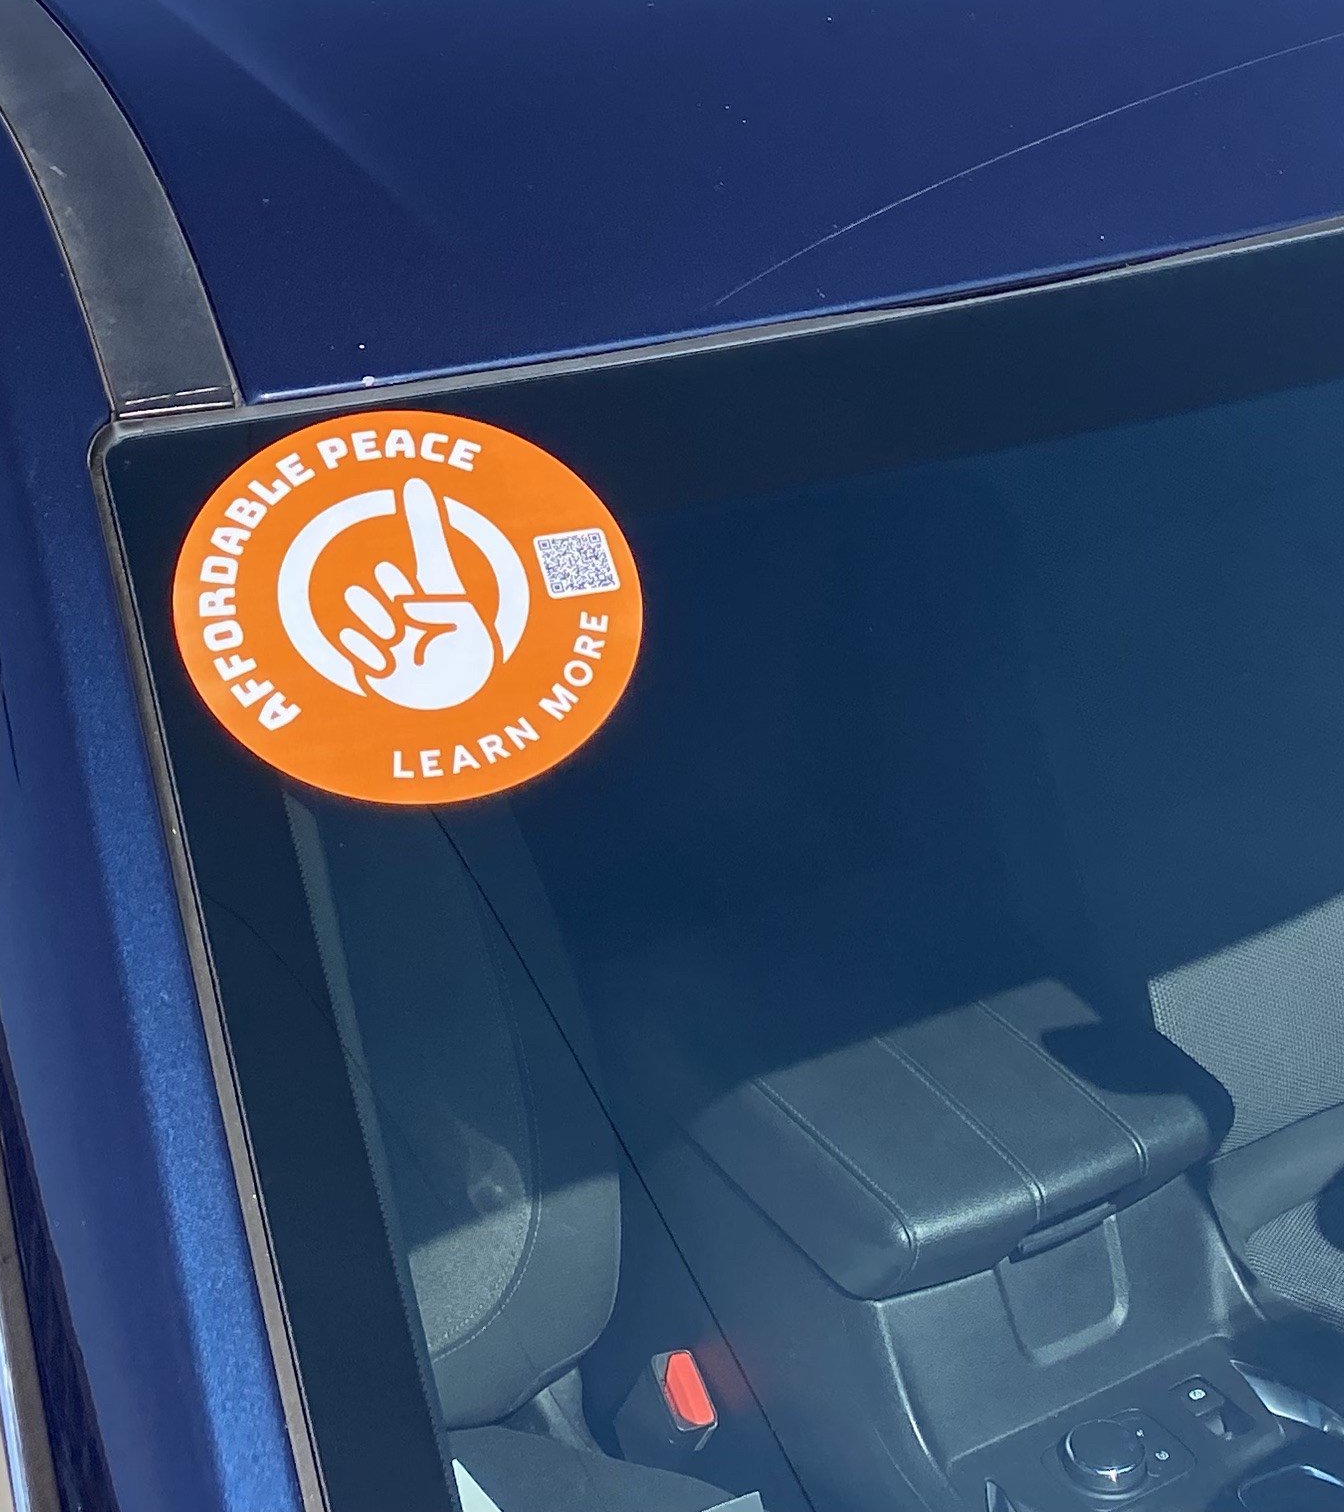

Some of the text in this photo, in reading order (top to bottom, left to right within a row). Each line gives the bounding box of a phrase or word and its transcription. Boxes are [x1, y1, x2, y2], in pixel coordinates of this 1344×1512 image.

[316, 429, 482, 472] PEACE
[199, 453, 316, 731] AFFORDABLE
[392, 611, 609, 780] LEARN MORE
